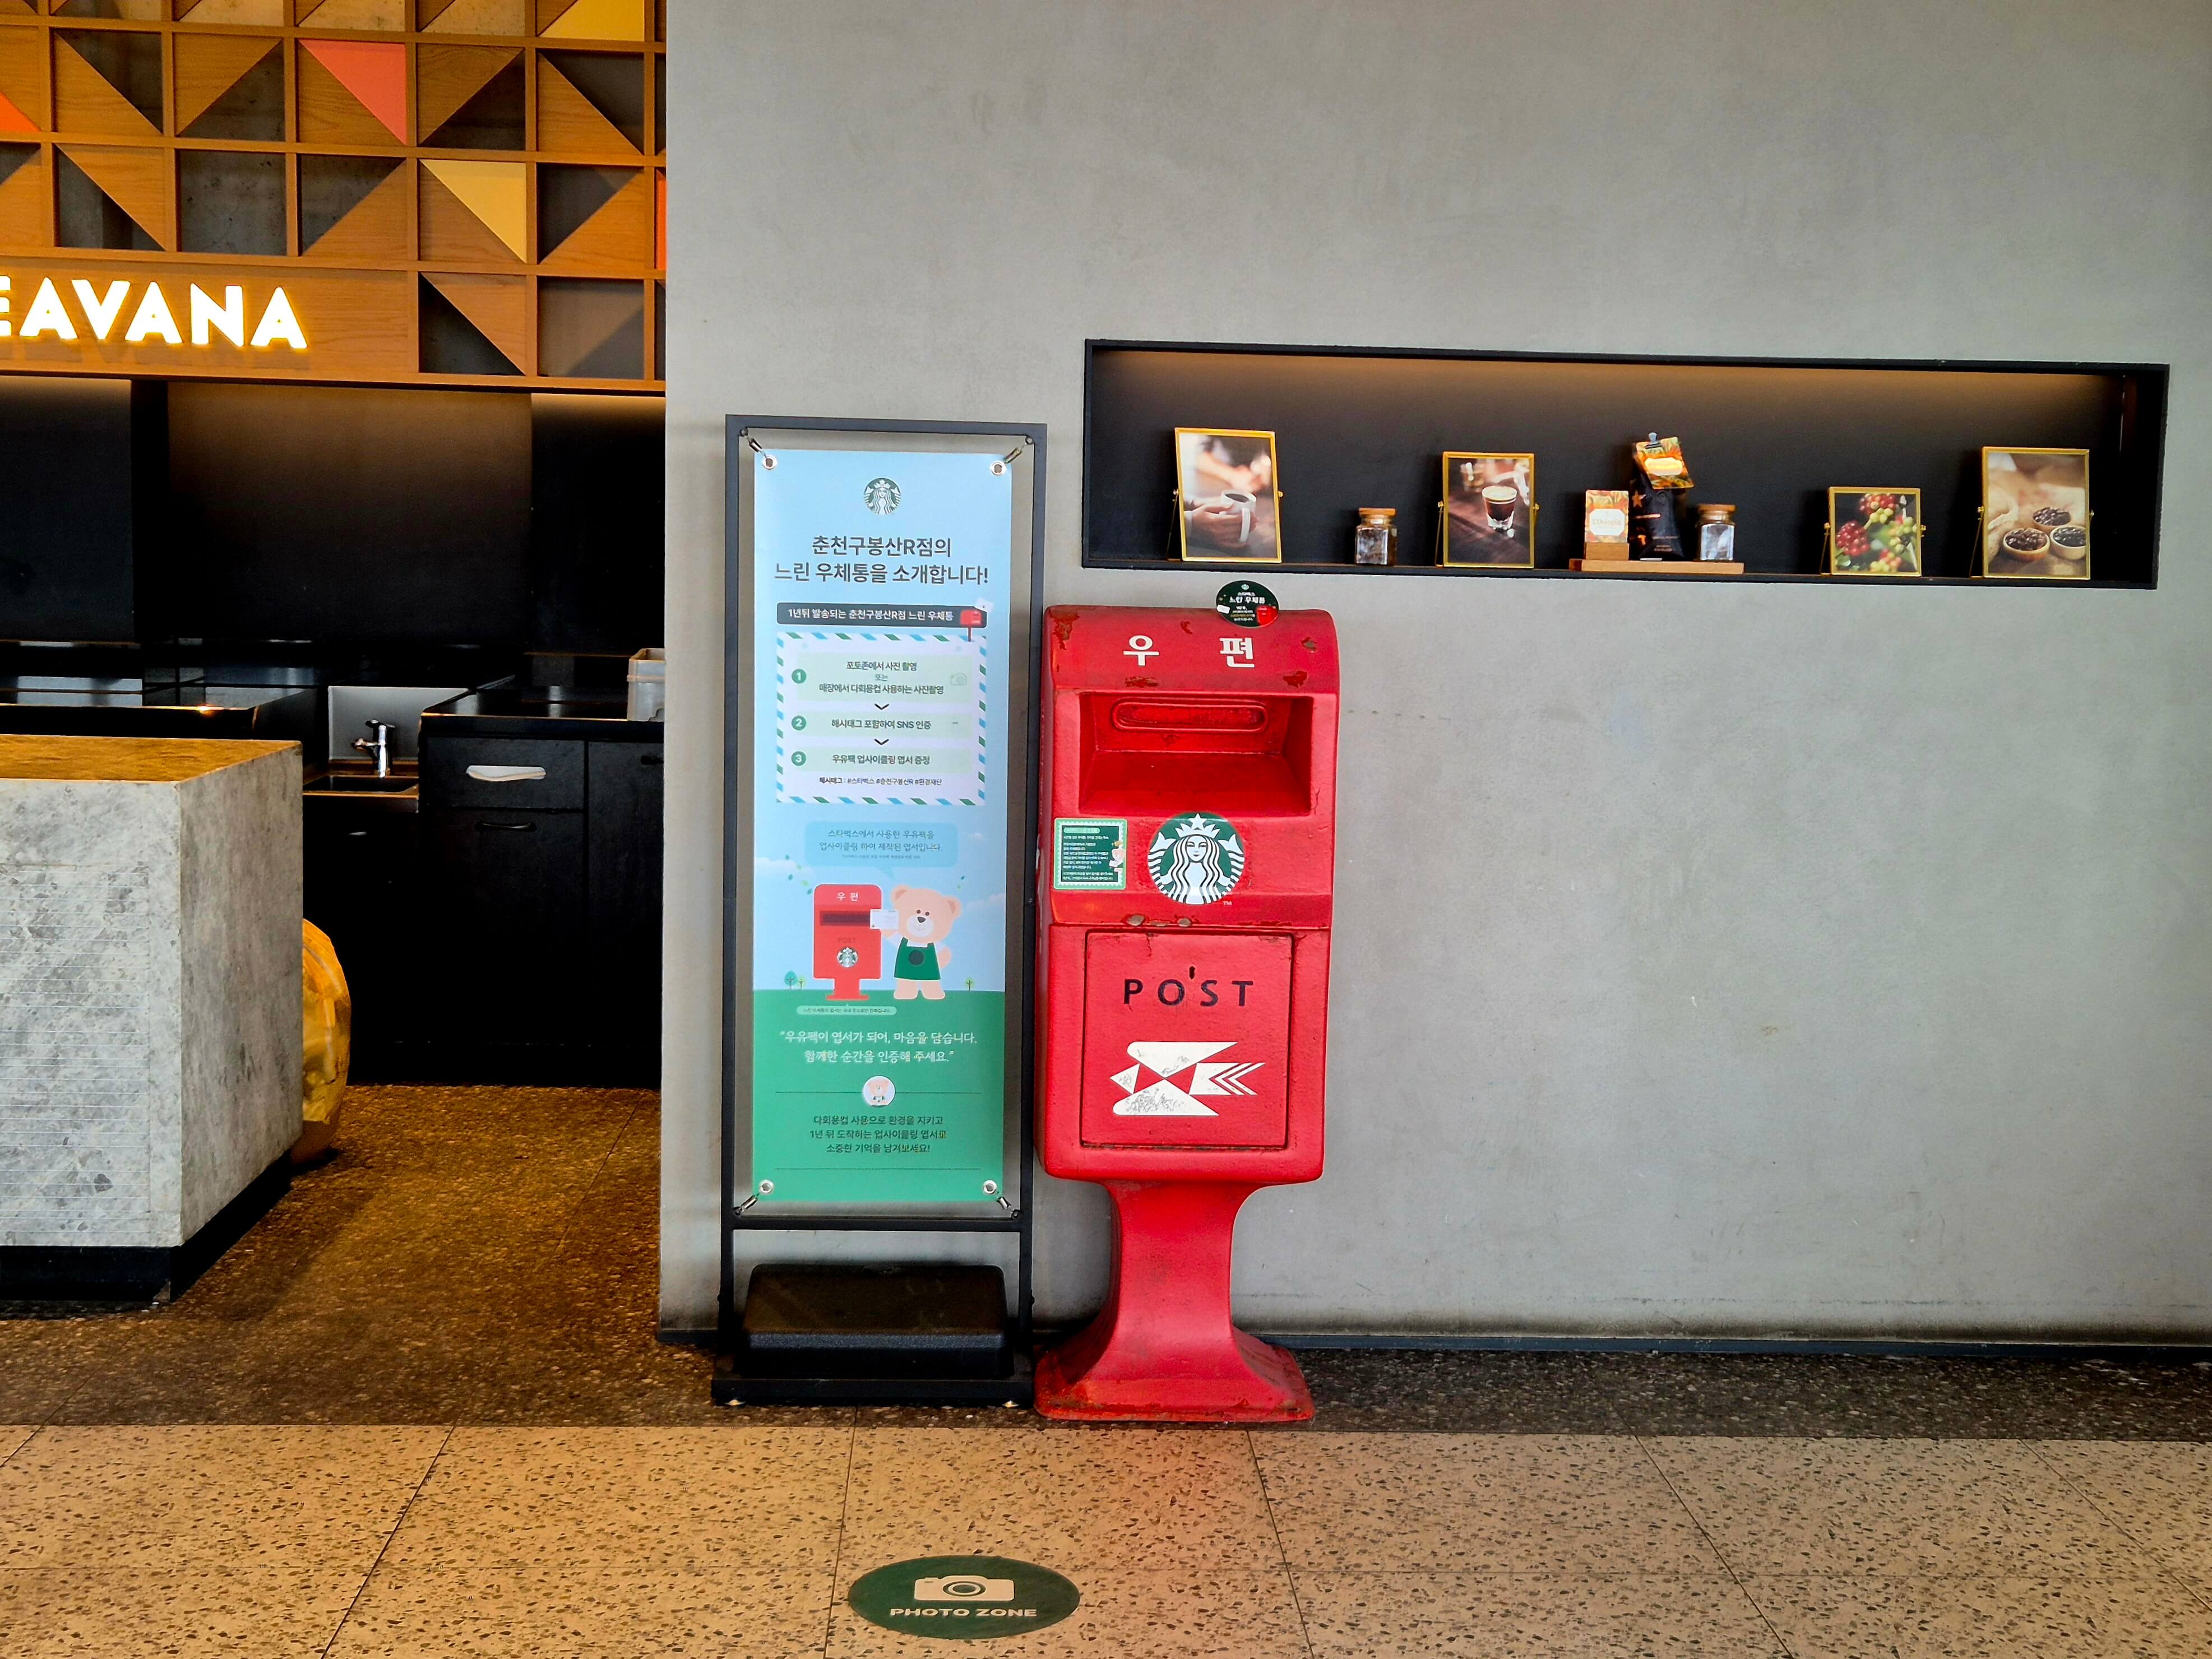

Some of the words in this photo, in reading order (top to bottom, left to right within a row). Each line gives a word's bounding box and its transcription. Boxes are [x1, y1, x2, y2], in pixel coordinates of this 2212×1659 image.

[812, 535, 951, 558] 춘천구봉산R점의
[775, 561, 810, 582] 느린
[816, 562, 888, 583] 우체통을
[892, 564, 988, 585] 소개합니다!
[788, 608, 810, 618] 1년뒤
[812, 608, 847, 619] 발송되는
[908, 610, 925, 620] 느린
[928, 610, 954, 621] 우체통
[886, 661, 901, 671] 사진
[902, 661, 917, 671] 촬영
[819, 683, 849, 693] 매장에서
[850, 684, 881, 694] 다회용컵
[882, 684, 913, 694] 사용하는
[914, 685, 944, 694] 사진촬영
[795, 718, 803, 727] 2
[832, 719, 862, 728] 해시태그
[864, 719, 895, 729] 포함하여
[897, 721, 914, 729] SNS
[915, 720, 932, 730] 인증
[795, 754, 803, 763] 3
[832, 754, 856, 764] 우유팩
[857, 755, 896, 764] 업사이클링
[897, 755, 913, 765] 엽서
[915, 756, 930, 765] 증정
[828, 830, 874, 838] 스타벅스에서
[876, 830, 900, 839] 사용한
[820, 842, 858, 851] 업사이클링
[878, 842, 901, 851] 제작된
[1123, 978, 1254, 1007] POST
[832, 1031, 864, 1044] 엽서가
[867, 1031, 891, 1045] 되어,
[894, 1031, 928, 1045] 마음을
[804, 1050, 838, 1063] 함께한
[841, 1050, 875, 1063] 순간을
[878, 1050, 910, 1064] 인증해
[813, 1115, 848, 1125] 다회용컵
[851, 1116, 886, 1125] 사용으로
[888, 1116, 914, 1125] 환경을
[917, 1116, 943, 1125] 지키고
[809, 1130, 823, 1139] 1년
[826, 1130, 835, 1139] 뒤
[837, 1130, 872, 1139] 도착하는
[874, 1130, 918, 1139] 업사이클링
[826, 1143, 852, 1153] 소중한
[855, 1144, 882, 1153] 기억을
[889, 1607, 970, 1618] PHOTO
[975, 1608, 1038, 1618] ZONE
